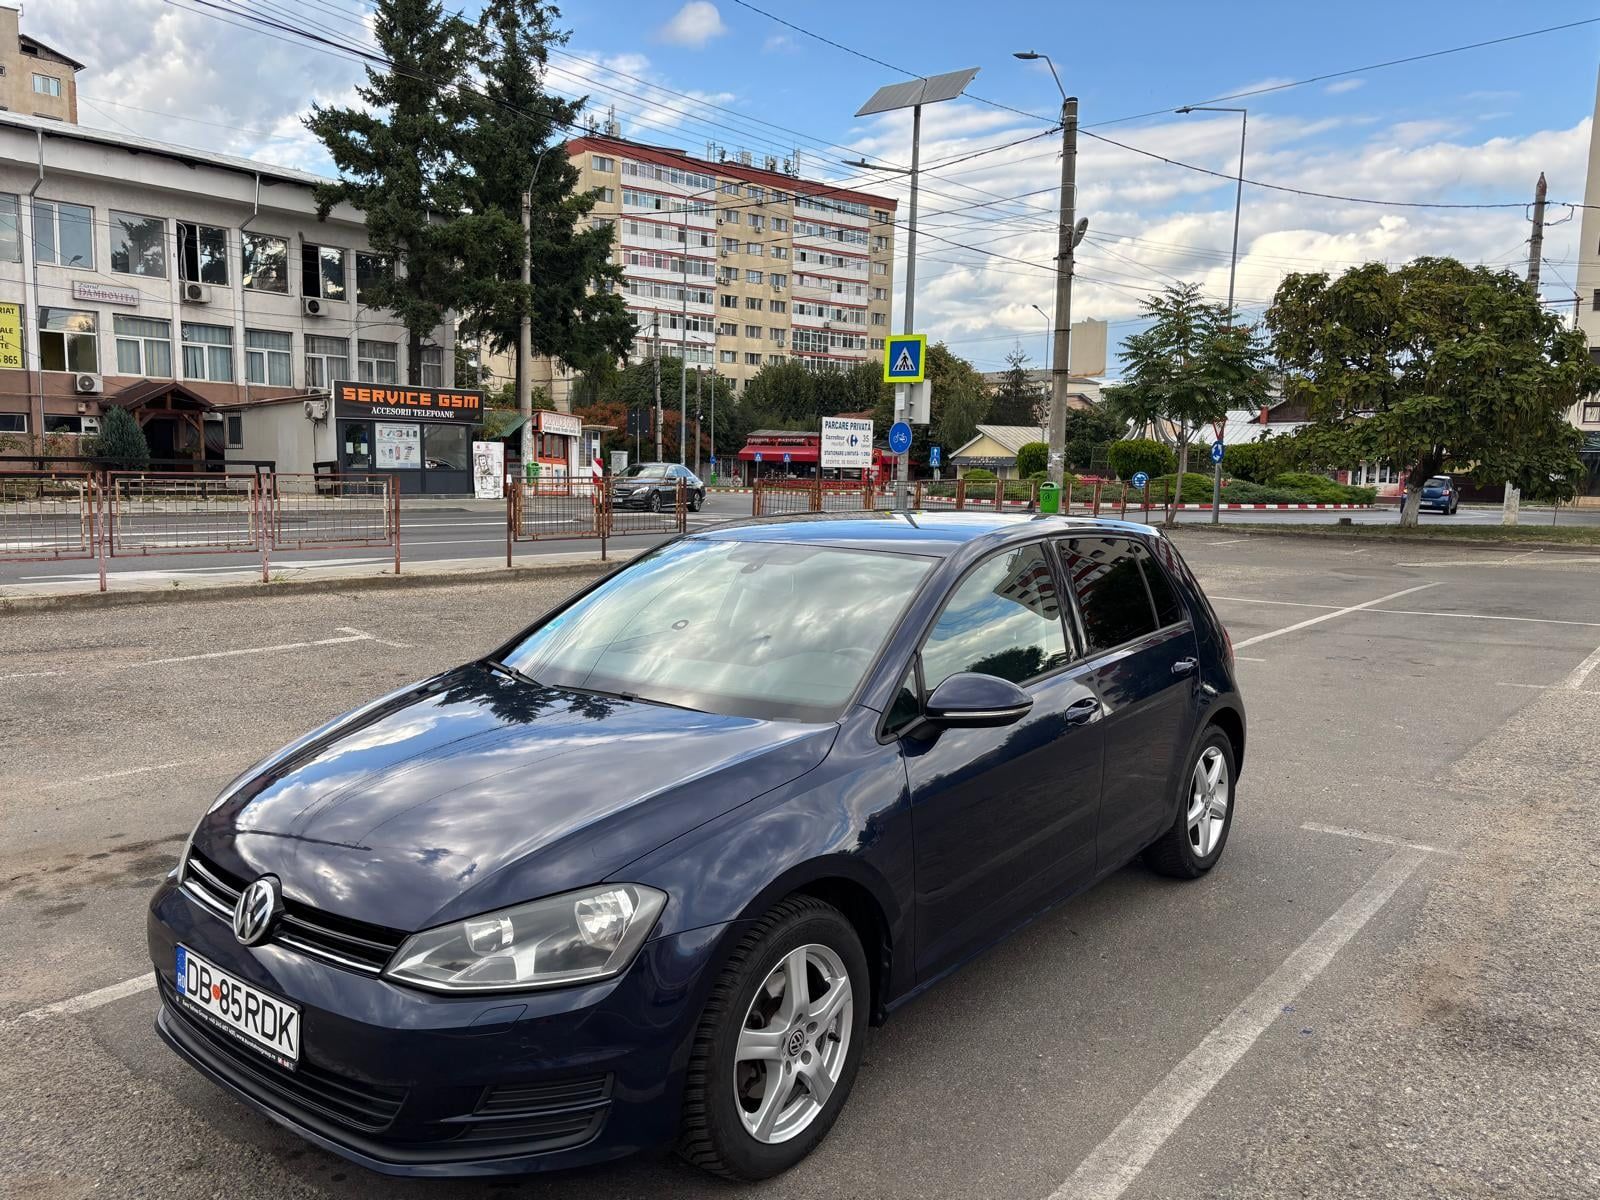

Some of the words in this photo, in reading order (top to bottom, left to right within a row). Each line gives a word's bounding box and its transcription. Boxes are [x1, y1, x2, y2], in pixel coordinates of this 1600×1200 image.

[3, 354, 18, 365] 865
[342, 387, 432, 406] SERVICE
[438, 393, 479, 409] GSM
[371, 406, 411, 417] ACCESORII
[413, 408, 455, 418] TELEFOANE
[825, 420, 849, 431] PARCARE
[177, 972, 186, 989] RO
[187, 957, 212, 1005] DB
